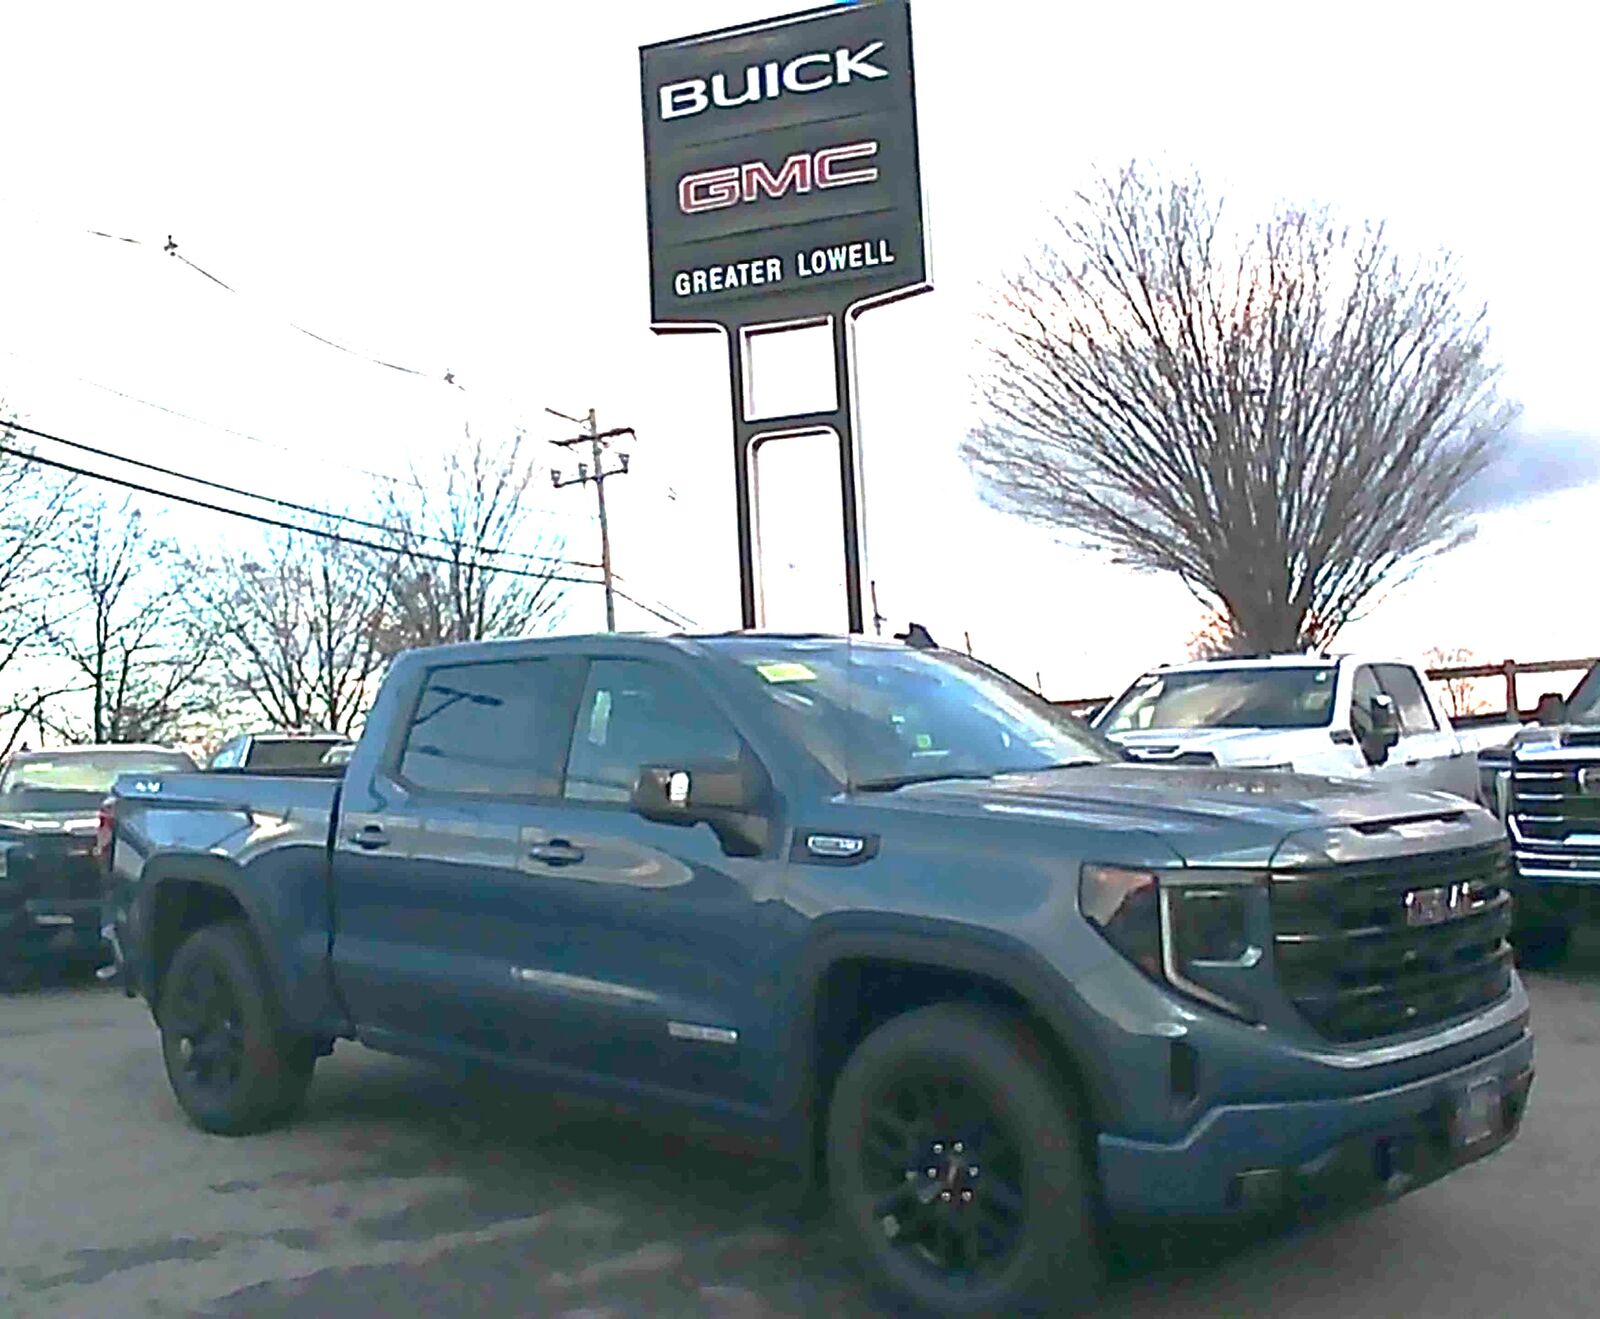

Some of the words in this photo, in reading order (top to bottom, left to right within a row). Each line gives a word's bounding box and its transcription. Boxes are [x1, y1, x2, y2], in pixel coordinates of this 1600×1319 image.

[660, 41, 889, 120] BUICK
[678, 141, 879, 214] GMC
[674, 258, 783, 296] GREATER
[798, 239, 895, 277] LOWELL
